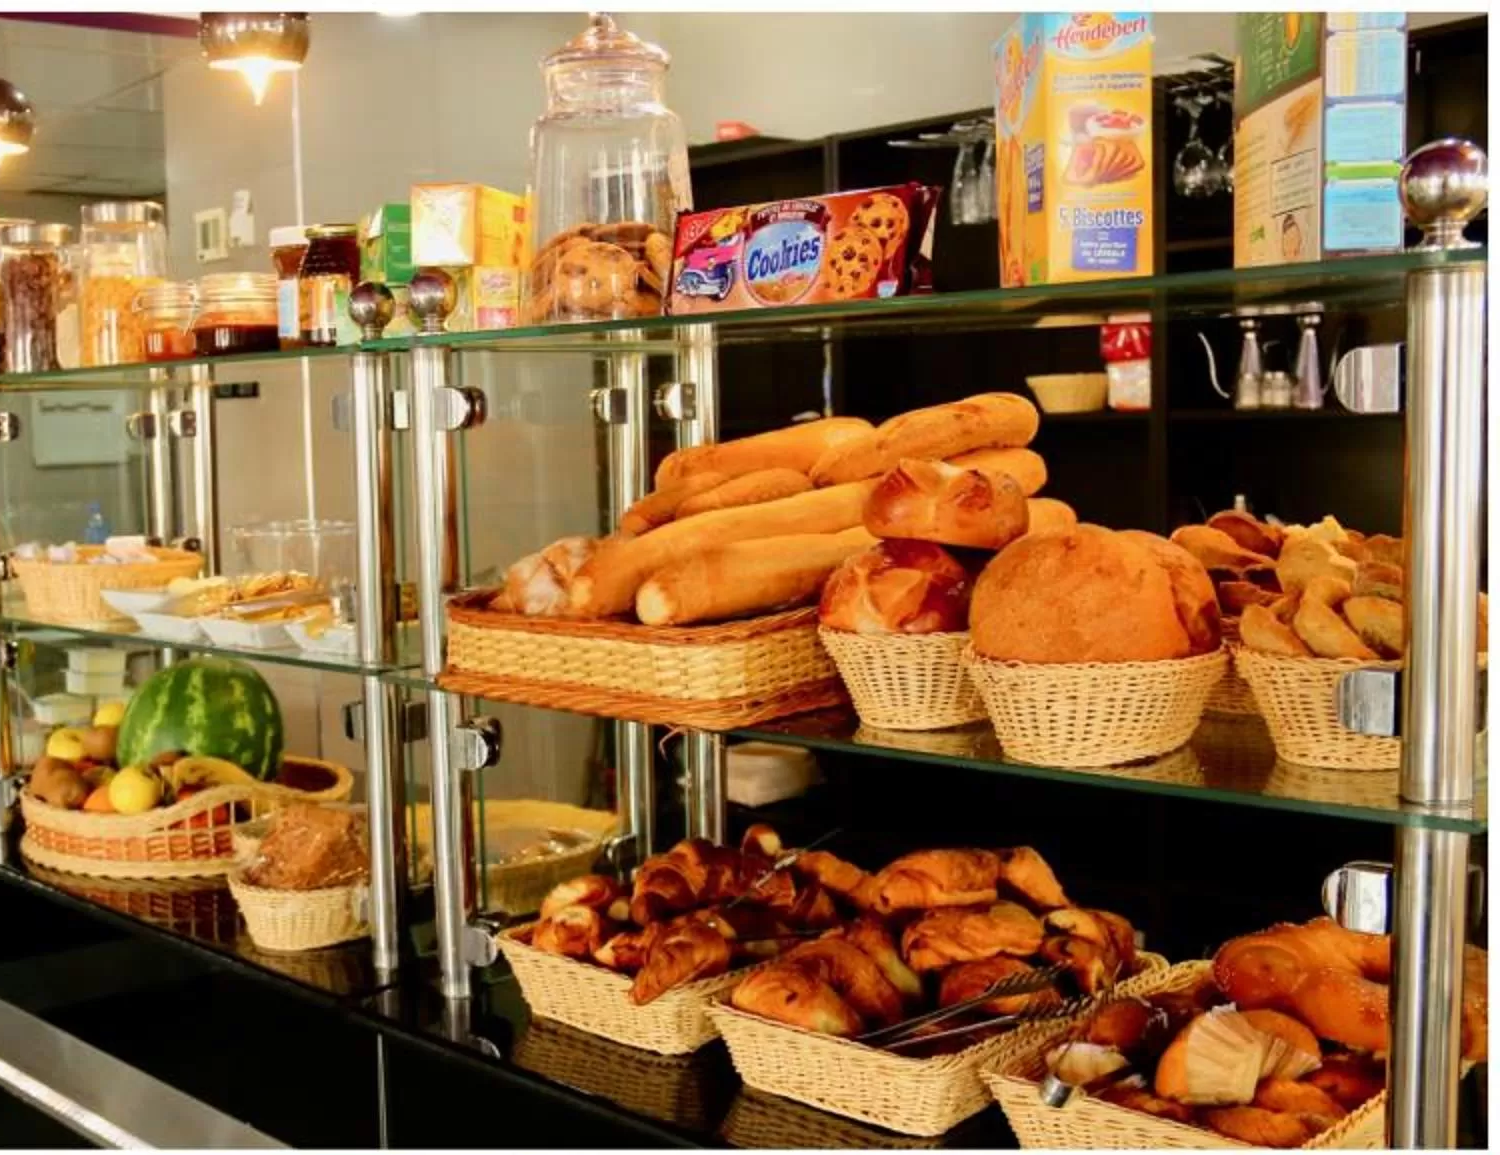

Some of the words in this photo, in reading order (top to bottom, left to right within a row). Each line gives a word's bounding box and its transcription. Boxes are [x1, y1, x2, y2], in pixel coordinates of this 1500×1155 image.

[1052, 17, 1146, 49] Heudebert
[1073, 207, 1143, 226] Biscottes
[748, 236, 821, 281] Cookies
